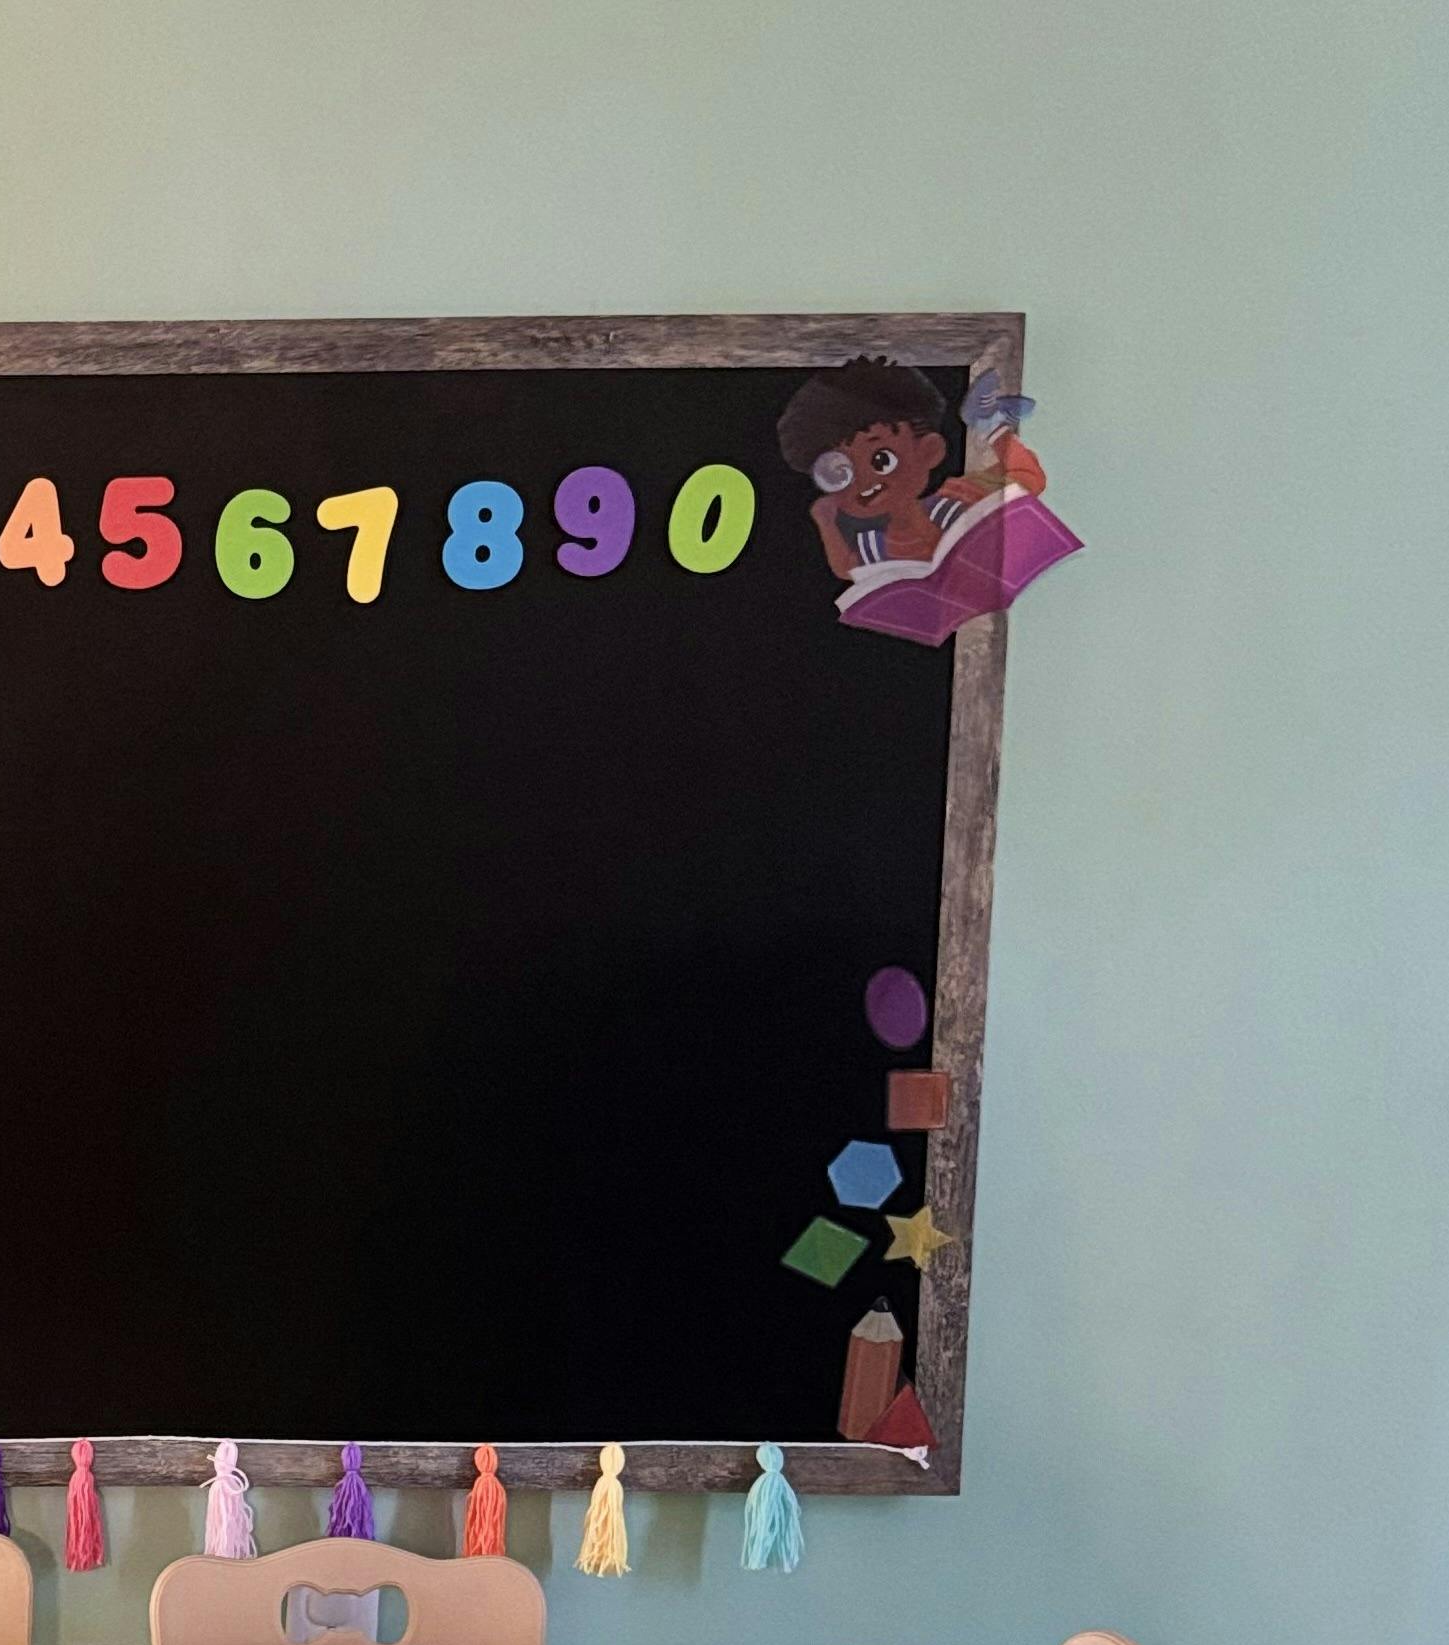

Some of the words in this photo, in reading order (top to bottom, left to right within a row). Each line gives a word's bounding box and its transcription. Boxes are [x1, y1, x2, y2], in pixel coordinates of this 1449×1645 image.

[99, 476, 183, 590] 5
[215, 488, 295, 599] 6
[316, 486, 399, 604] 7
[442, 480, 524, 590] 8
[554, 466, 635, 577] 9
[668, 464, 755, 574] 0
